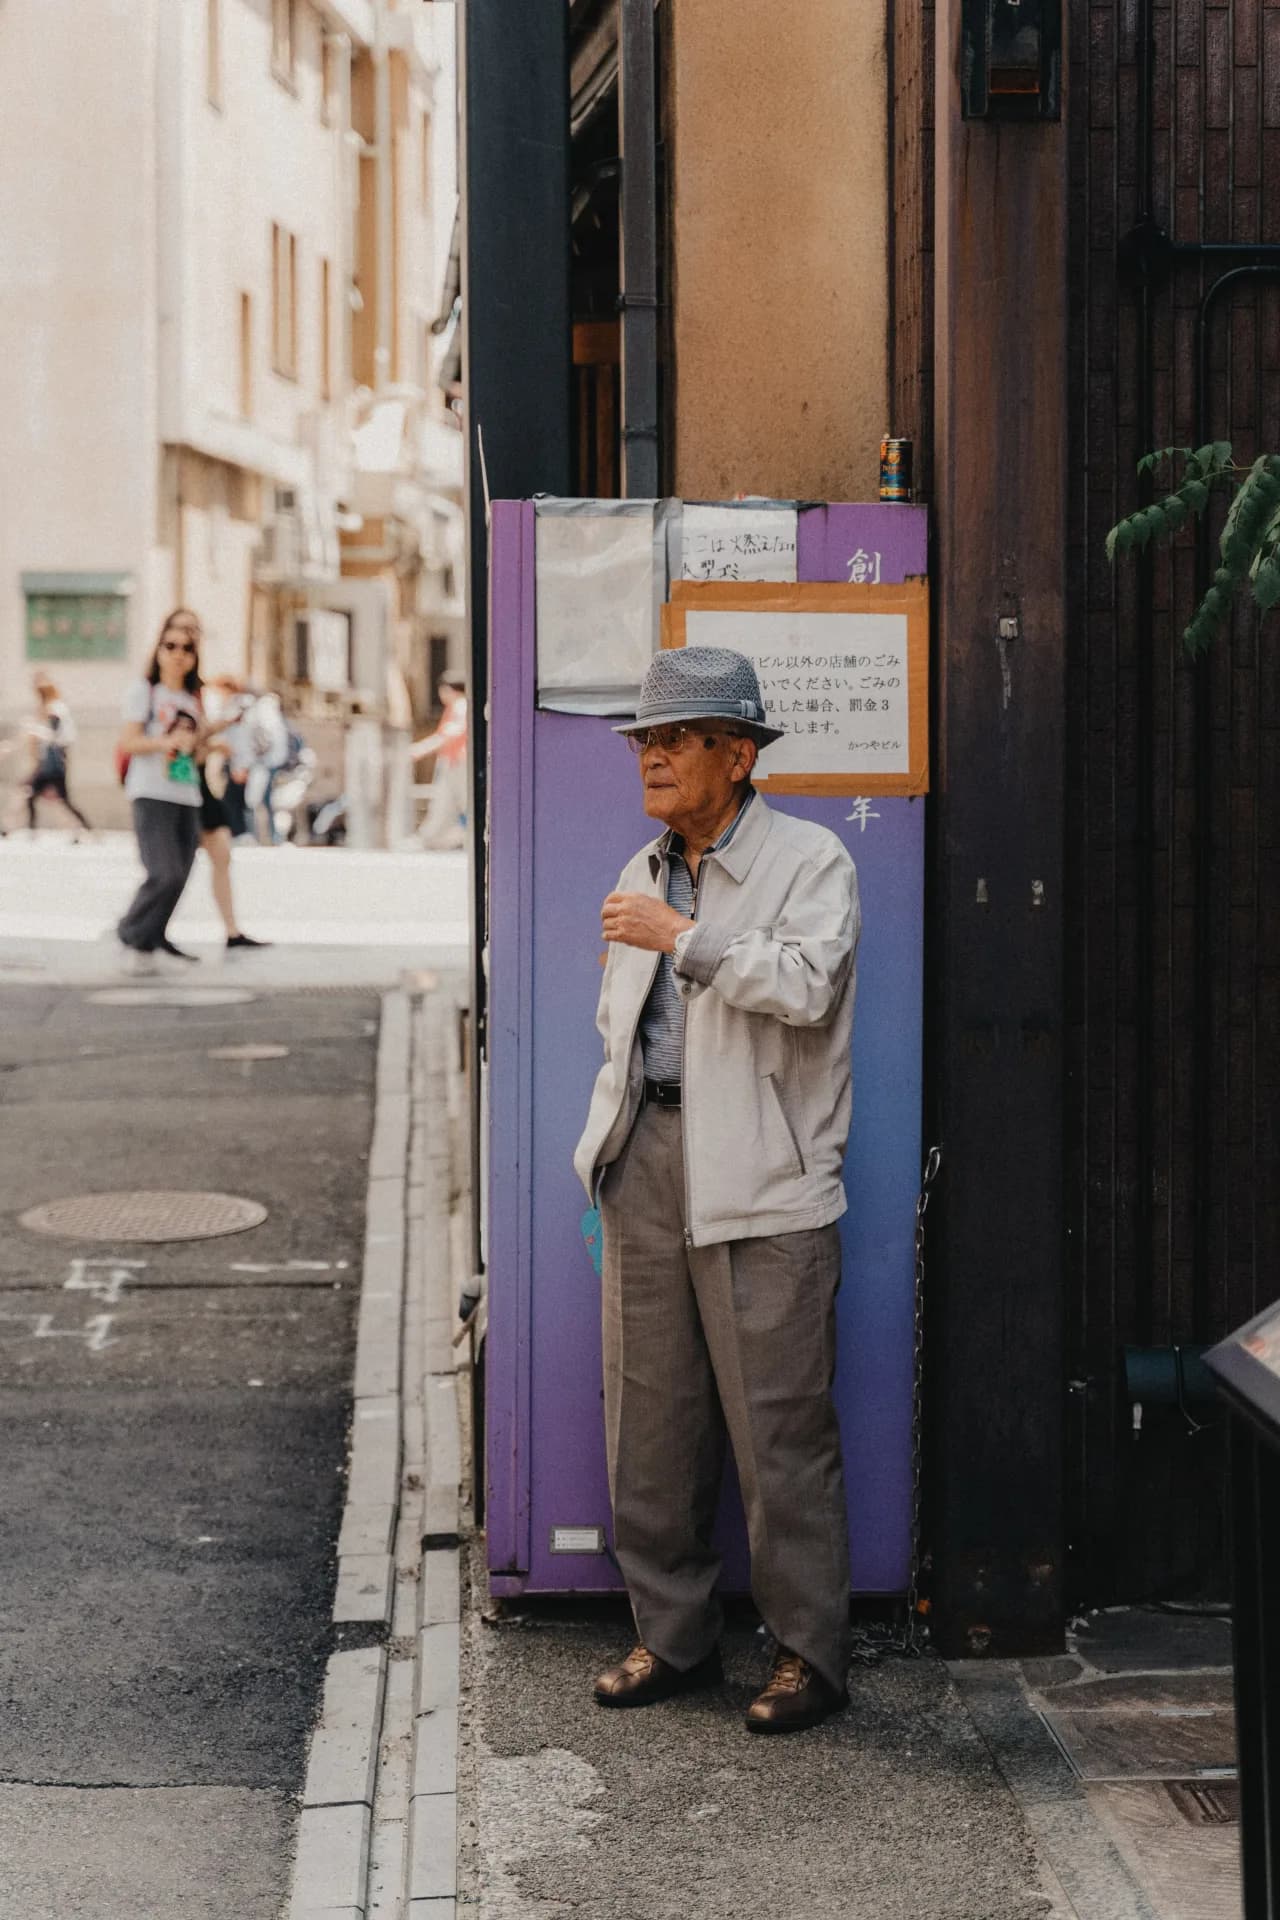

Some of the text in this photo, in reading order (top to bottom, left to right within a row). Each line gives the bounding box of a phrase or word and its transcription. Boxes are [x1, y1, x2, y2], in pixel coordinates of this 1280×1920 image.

[749, 654, 901, 669] ビル以外の店舗のごみ
[757, 677, 900, 691] いでください。ごみの
[845, 548, 881, 833] 創 年
[771, 720, 840, 735] たします。
[848, 740, 901, 751] かつやビル
